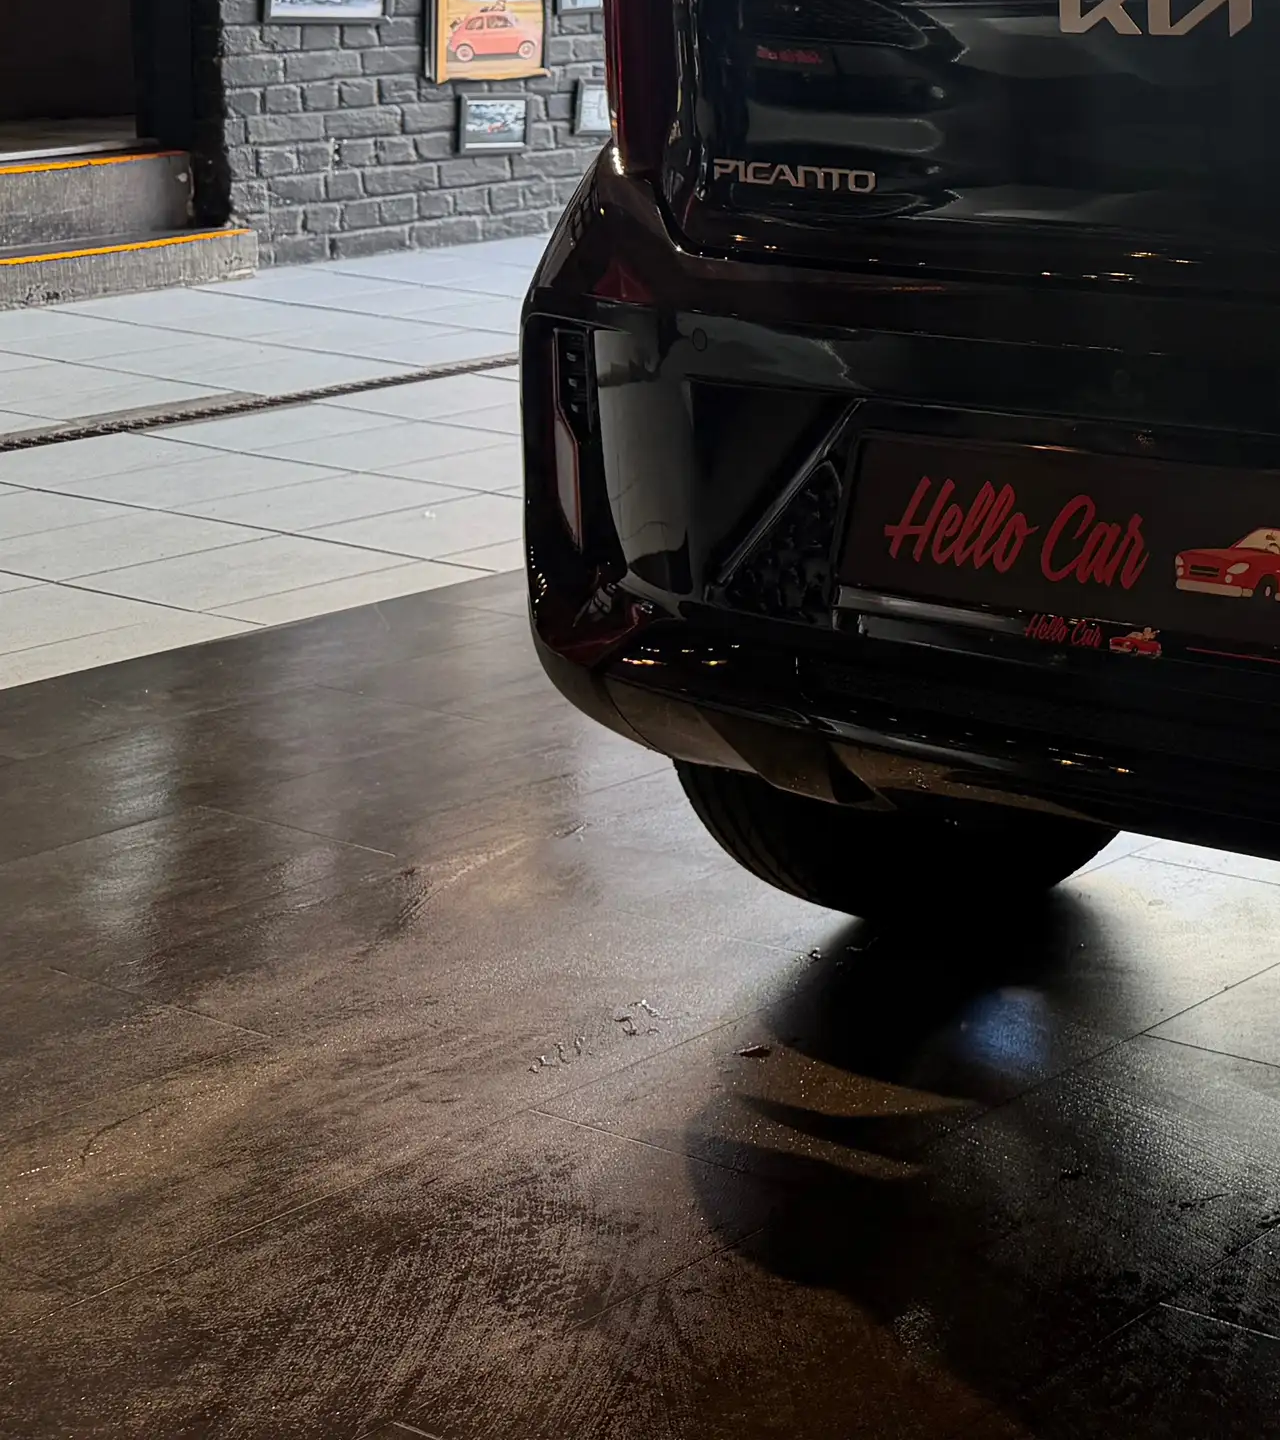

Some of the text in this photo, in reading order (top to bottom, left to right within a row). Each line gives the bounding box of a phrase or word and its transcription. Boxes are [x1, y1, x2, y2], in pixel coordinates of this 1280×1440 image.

[714, 158, 876, 193] PICANTO
[884, 476, 1150, 590] Hello Car
[1024, 614, 1102, 647] Hello Car
